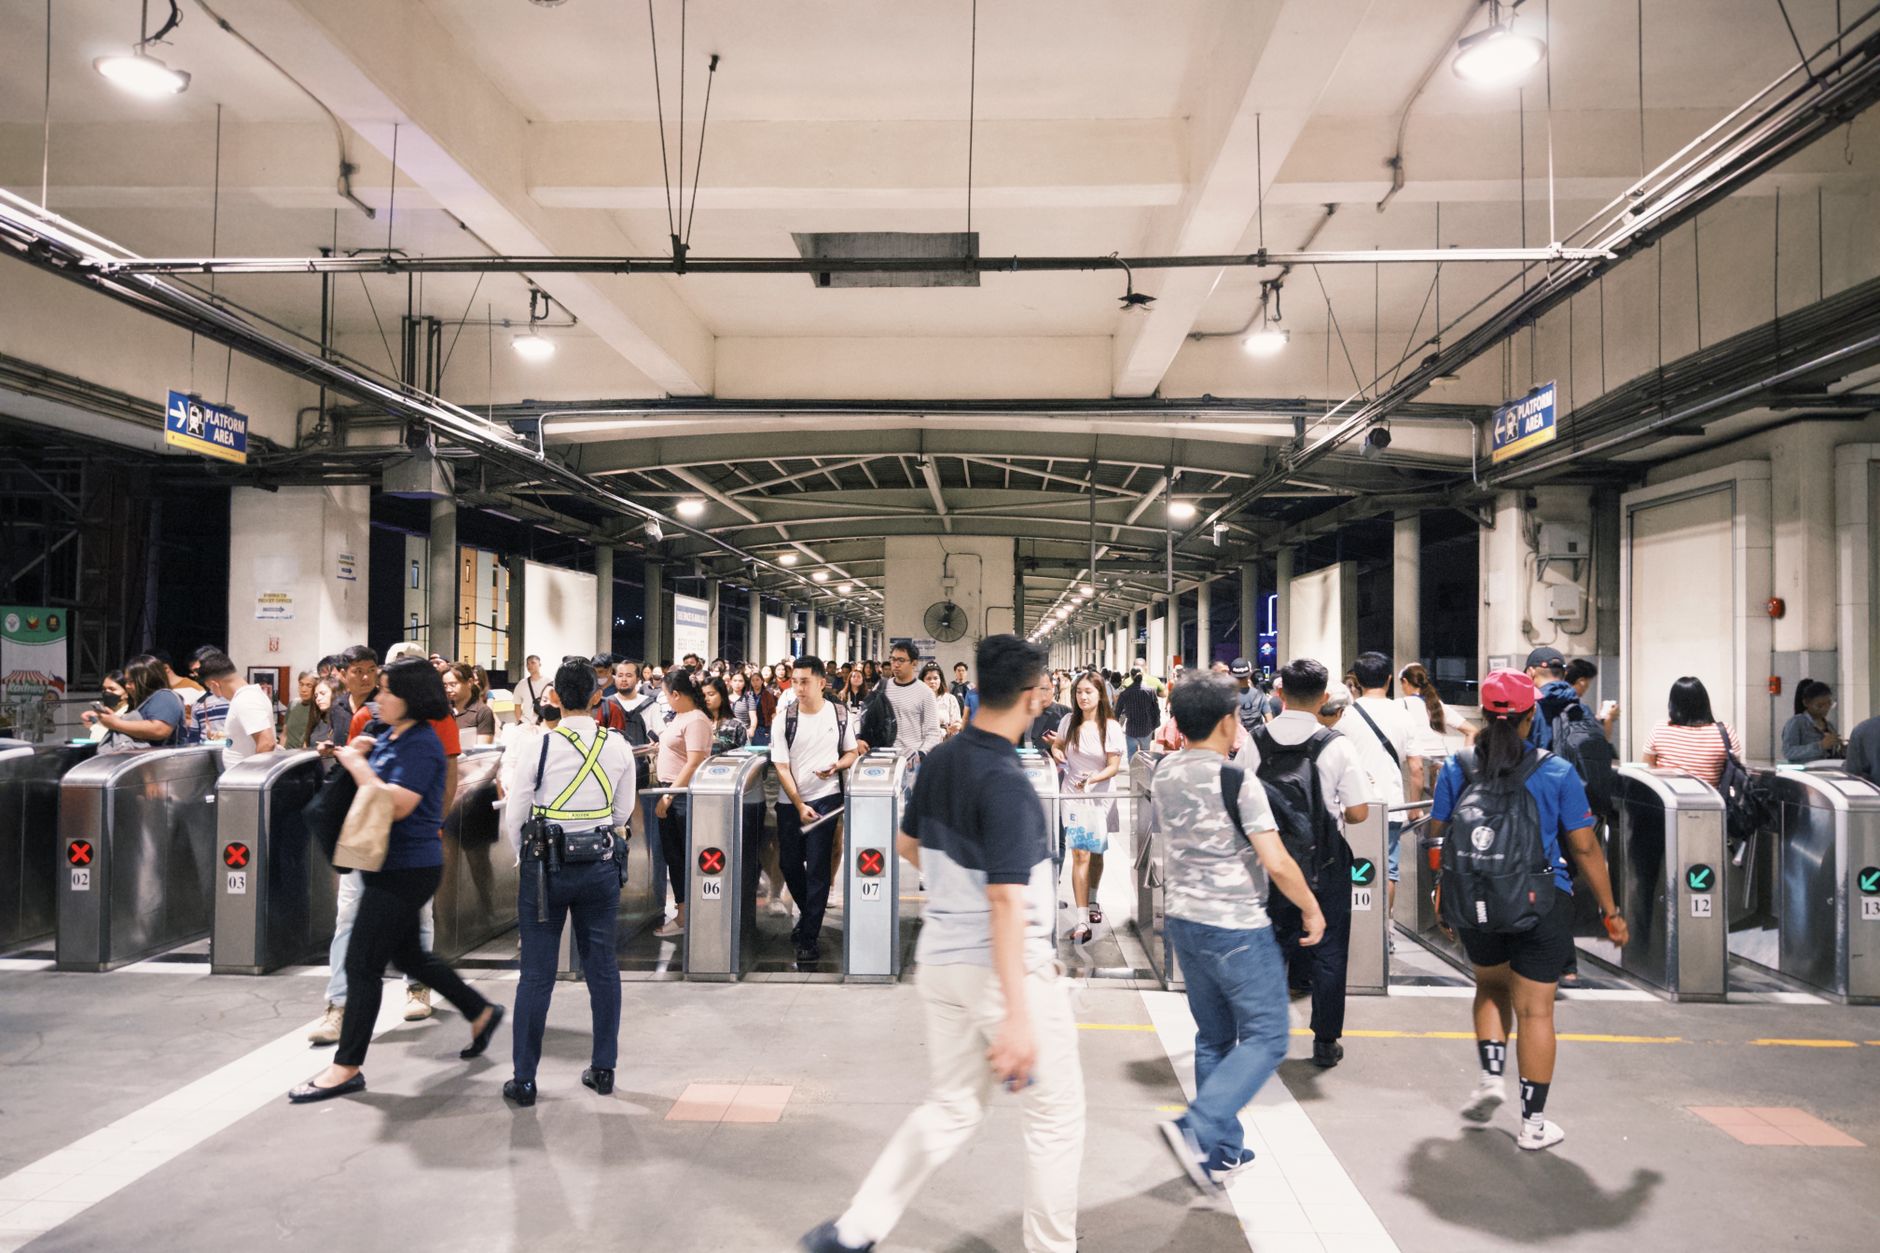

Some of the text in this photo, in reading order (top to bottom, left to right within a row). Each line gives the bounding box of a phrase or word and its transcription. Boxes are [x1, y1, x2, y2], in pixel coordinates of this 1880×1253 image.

[1518, 389, 1553, 420] PLATFORM
[205, 408, 245, 435] PLATFORM
[1525, 412, 1544, 434] AREA
[213, 427, 235, 447] AREA
[72, 873, 88, 886] 02
[229, 876, 245, 889] 03
[703, 881, 720, 895] 06
[862, 883, 879, 896] 07
[1354, 892, 1370, 905] 10
[1694, 899, 1710, 912] 12
[1865, 901, 1880, 915] 13
